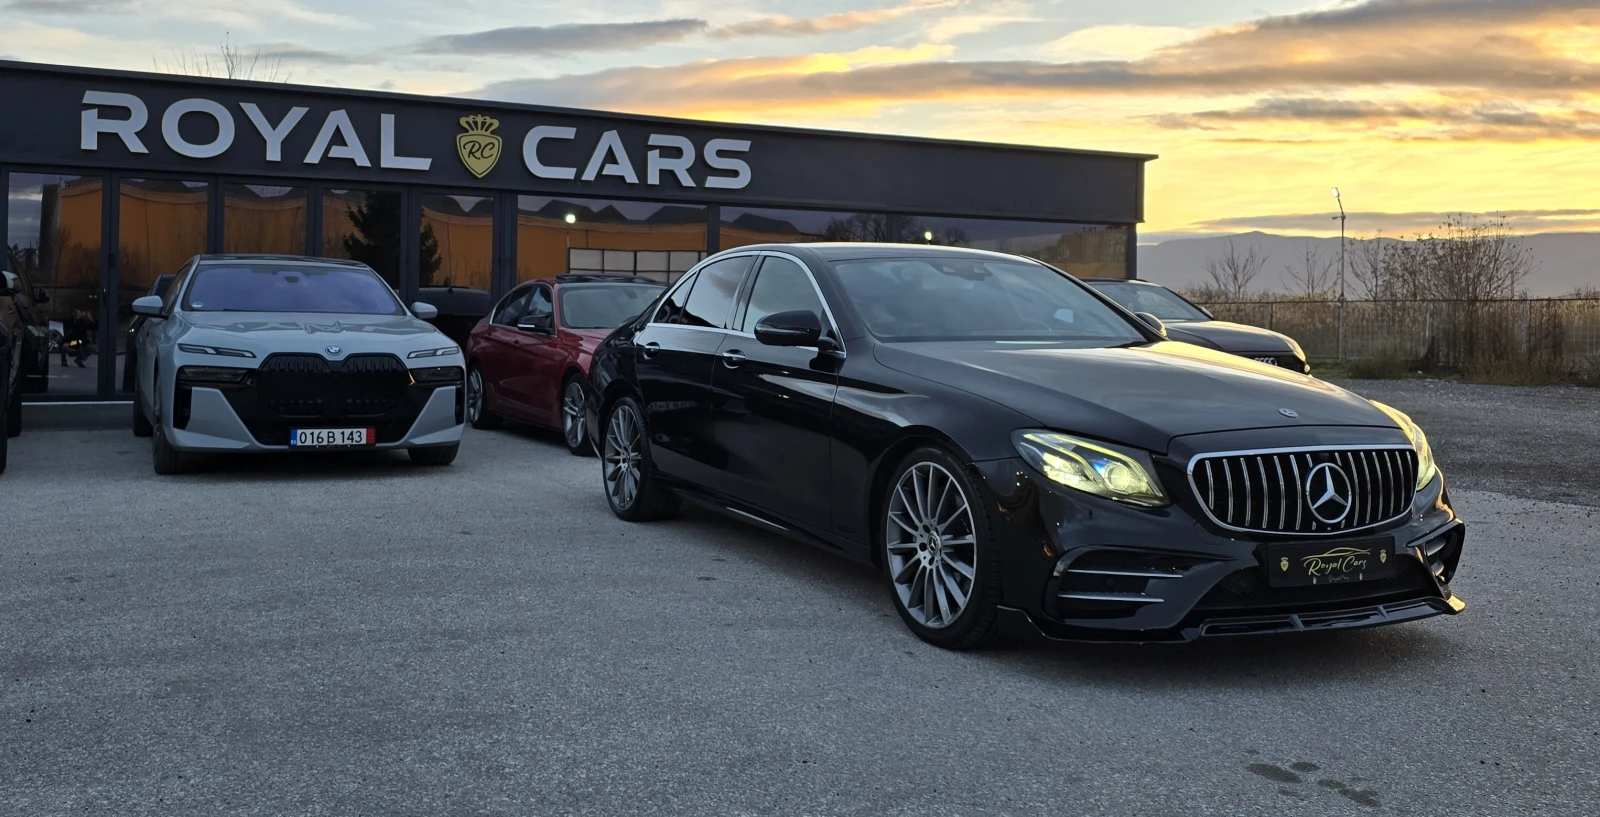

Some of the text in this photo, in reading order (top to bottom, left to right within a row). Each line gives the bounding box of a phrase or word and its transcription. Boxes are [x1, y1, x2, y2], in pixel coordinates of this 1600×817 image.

[80, 90, 752, 189] ROYAL CARS
[463, 140, 495, 160] RC
[299, 430, 363, 444] 016 B 143
[1303, 555, 1367, 576] Royal Cars
